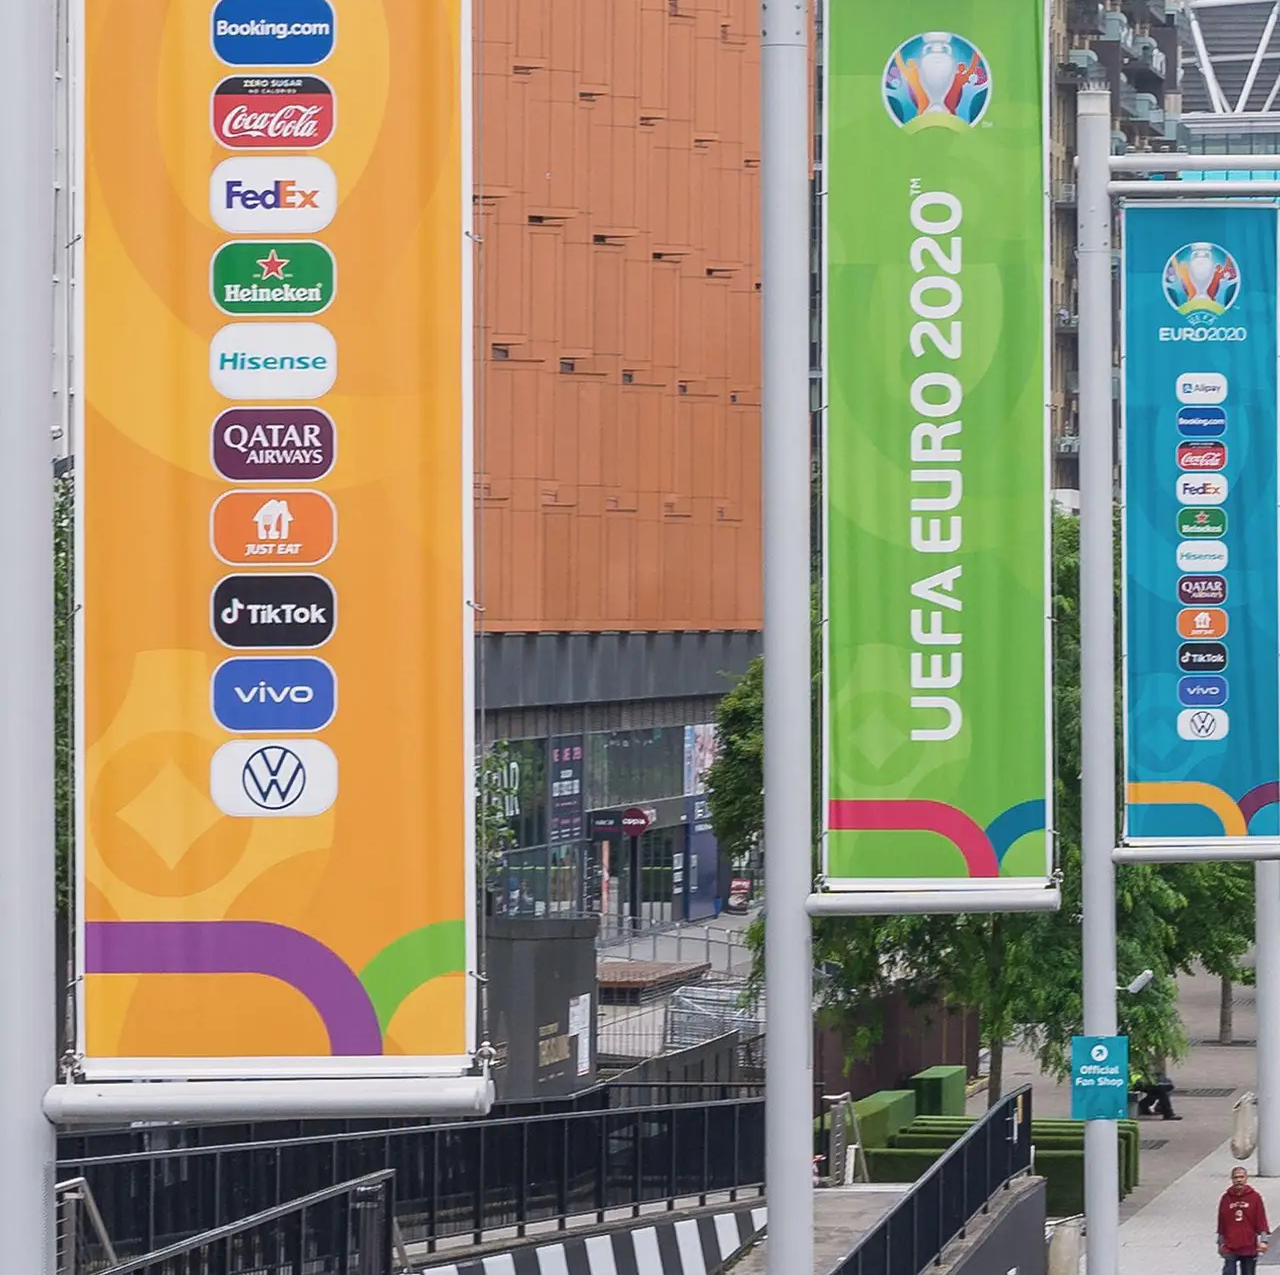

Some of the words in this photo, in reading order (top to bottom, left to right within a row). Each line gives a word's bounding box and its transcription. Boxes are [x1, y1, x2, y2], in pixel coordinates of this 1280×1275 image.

[216, 19, 330, 39] Booking.com
[243, 79, 269, 88] ZERO
[270, 79, 303, 88] SUGAR
[226, 180, 320, 210] FedEx
[911, 191, 963, 361] 2020
[224, 283, 322, 302] Heineken
[219, 352, 327, 371] Hisense
[223, 424, 322, 452] QATAR
[245, 449, 323, 464] AIRWAYS
[911, 373, 963, 554] EURO
[1182, 482, 1221, 495] FedEx
[244, 543, 276, 556] JUST
[277, 543, 302, 555] EAT
[1181, 581, 1223, 593] QATAR
[246, 604, 327, 624] TikTok
[911, 567, 963, 742] UEFA
[234, 681, 314, 703] vivo
[1186, 685, 1220, 695] vivo
[1080, 1065, 1120, 1075] Official
[1075, 1077, 1096, 1086] Fan
[1097, 1077, 1124, 1087] Shop
